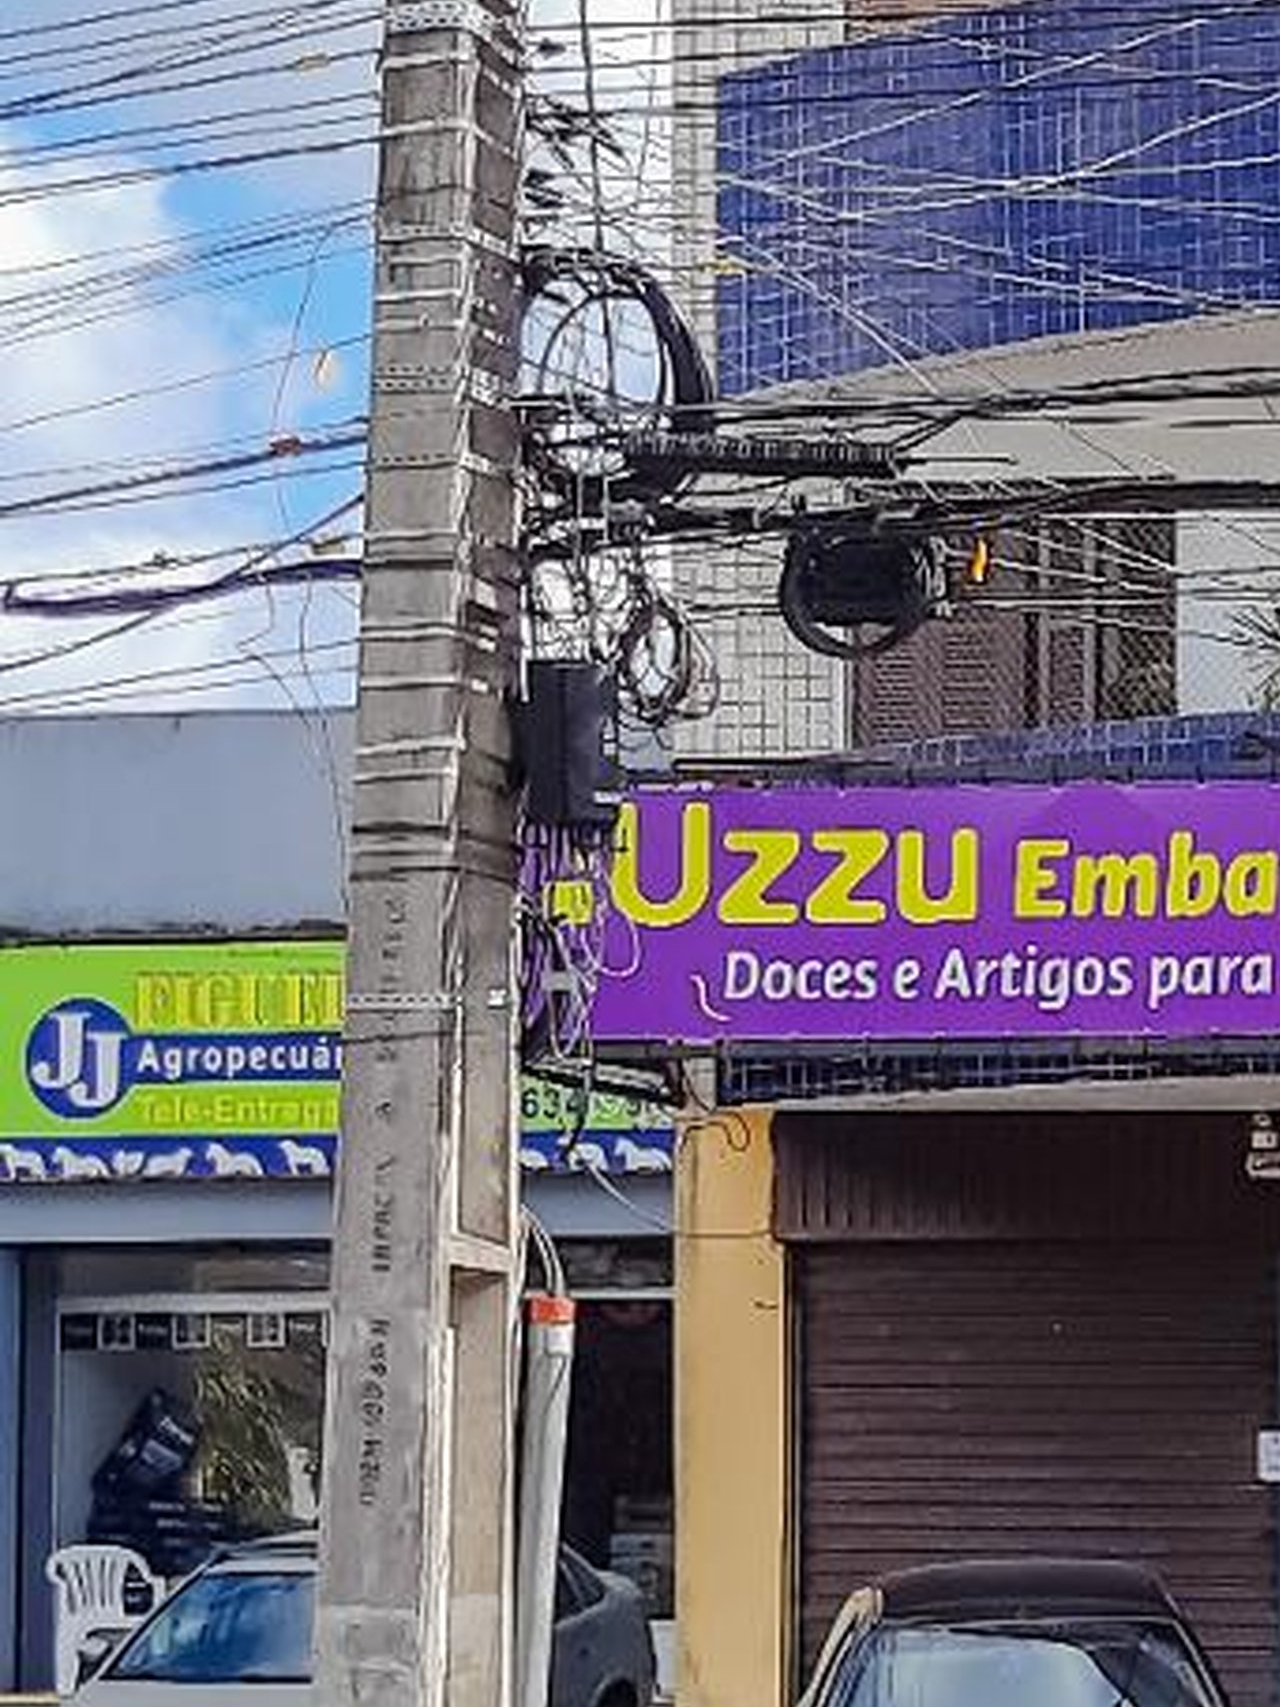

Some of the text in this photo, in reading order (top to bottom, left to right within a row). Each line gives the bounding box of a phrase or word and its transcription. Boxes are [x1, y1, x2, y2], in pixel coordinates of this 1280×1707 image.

[722, 948, 879, 1000] Doces
[892, 958, 918, 1000] e
[933, 944, 1133, 1011] Artigos
[1149, 951, 1272, 1011] para
